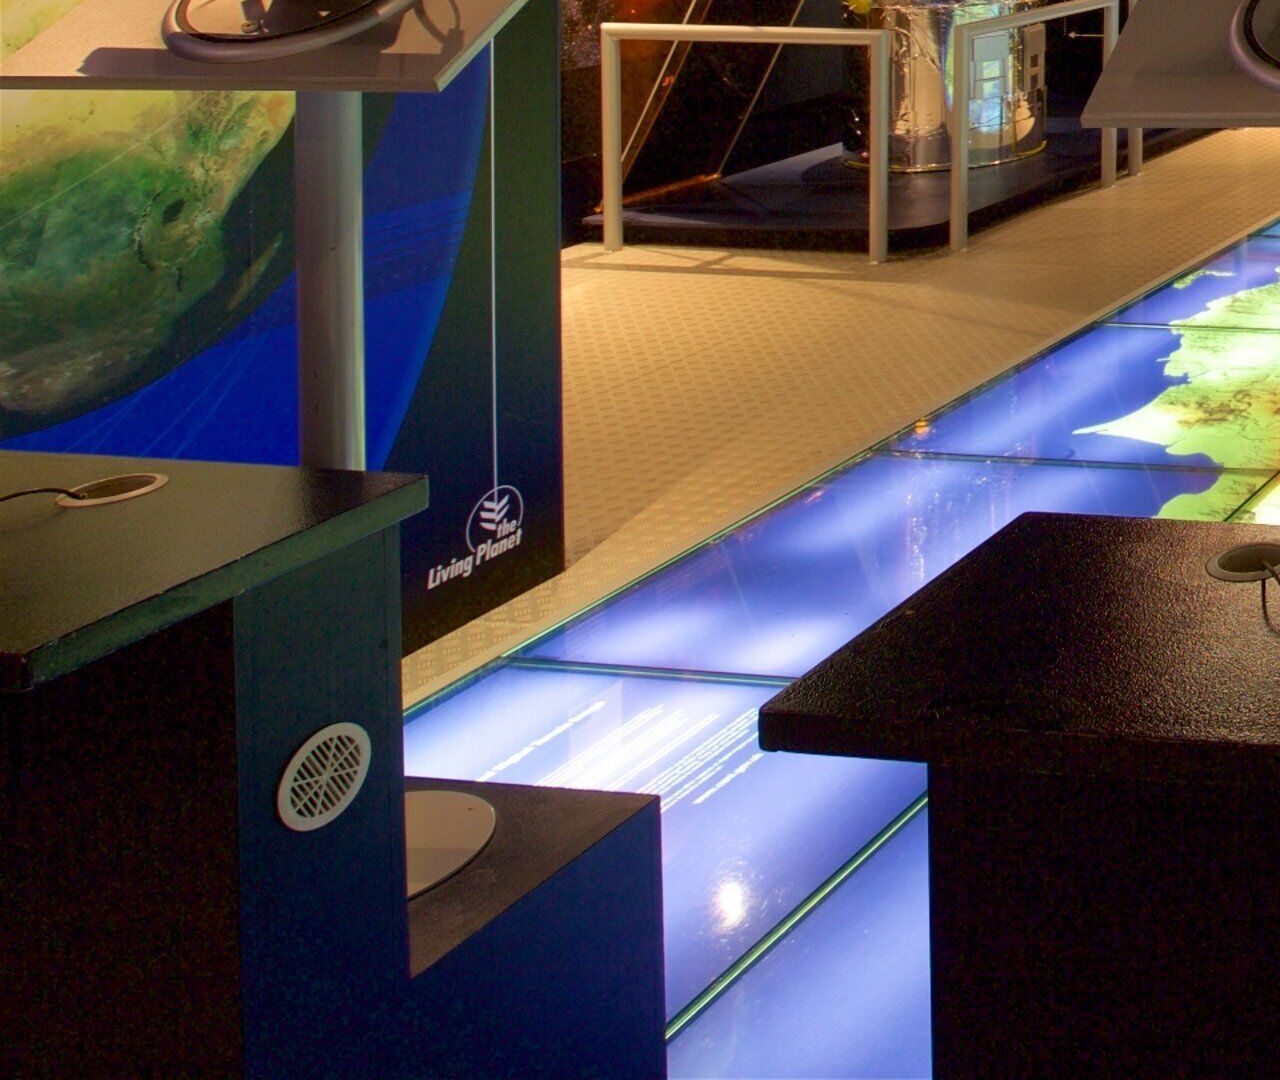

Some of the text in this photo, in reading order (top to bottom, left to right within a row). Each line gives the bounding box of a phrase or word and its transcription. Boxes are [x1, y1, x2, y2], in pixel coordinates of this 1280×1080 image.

[496, 517, 518, 539] the
[427, 527, 522, 591] Living Planet
